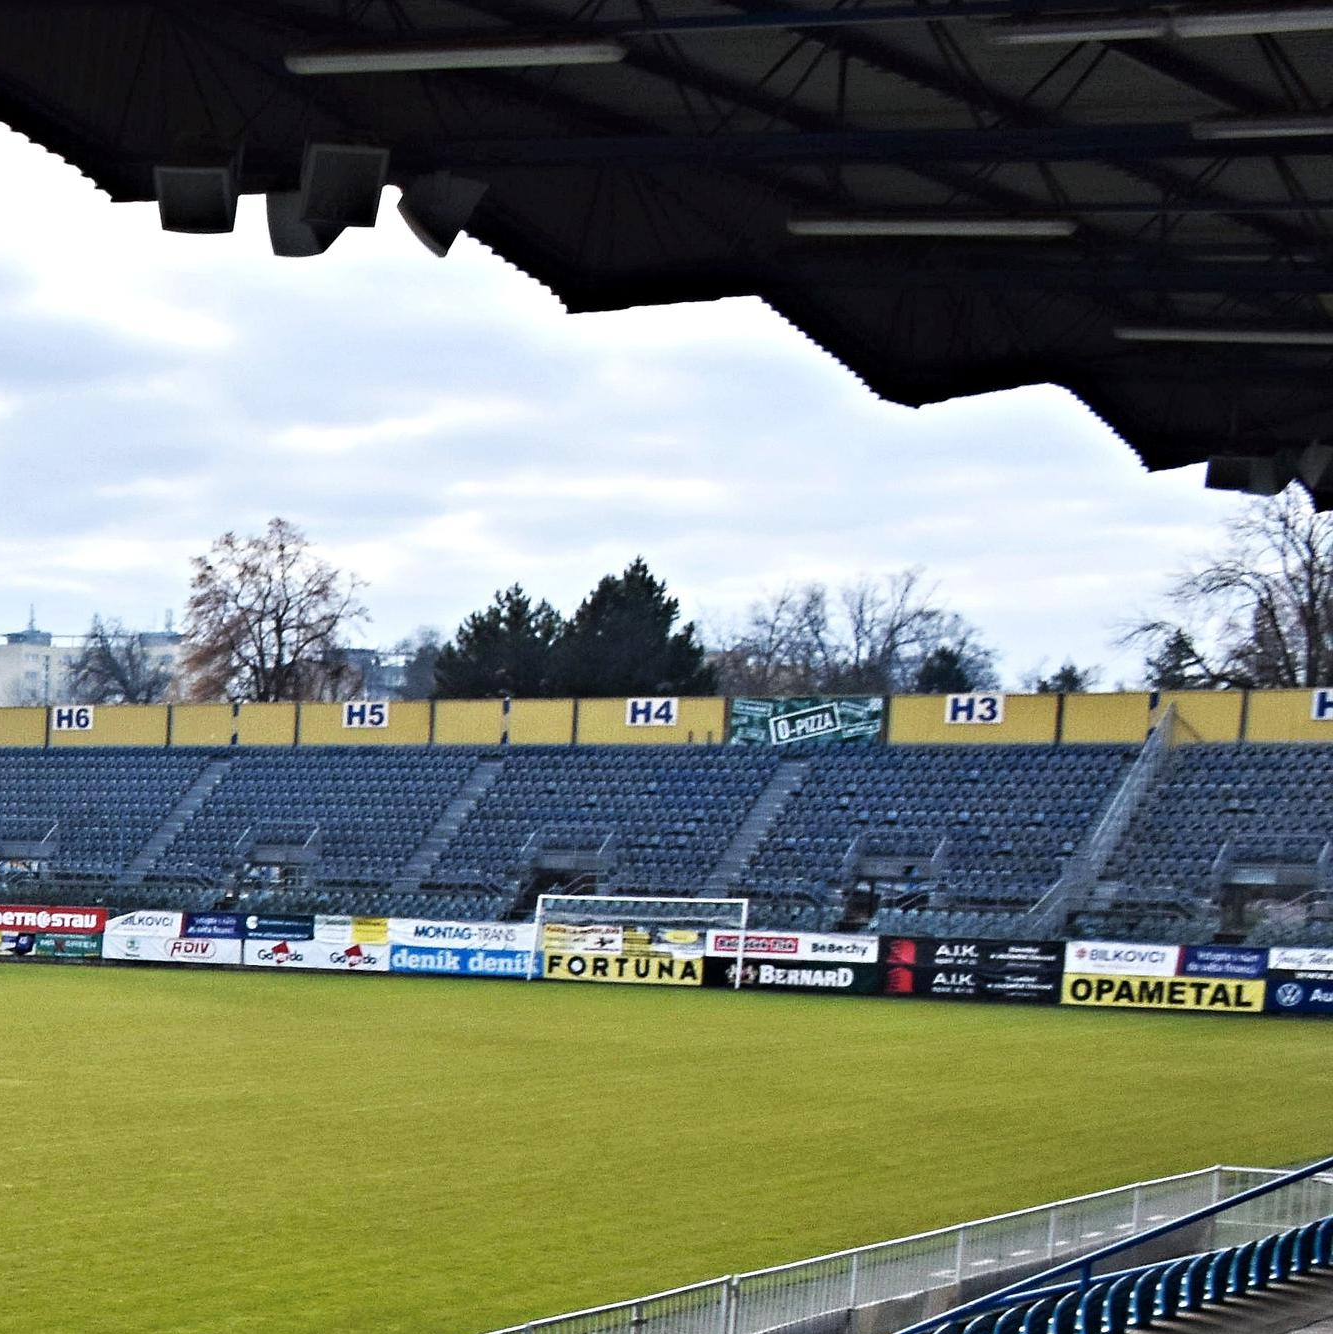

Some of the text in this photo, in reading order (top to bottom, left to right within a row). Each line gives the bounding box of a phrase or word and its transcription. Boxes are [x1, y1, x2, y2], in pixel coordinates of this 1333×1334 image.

[347, 704, 383, 725] H5
[631, 701, 673, 723] H4
[950, 697, 997, 721] H3
[1317, 692, 1333, 717] H
[57, 708, 89, 728] H6
[393, 948, 461, 970] deník
[935, 944, 979, 957] A.I.K.
[1089, 948, 1166, 963] BILKOVCI
[548, 955, 697, 980] FORTUNA
[932, 973, 976, 986] A.I.K.
[1070, 978, 1253, 1008] OPAMETAL
